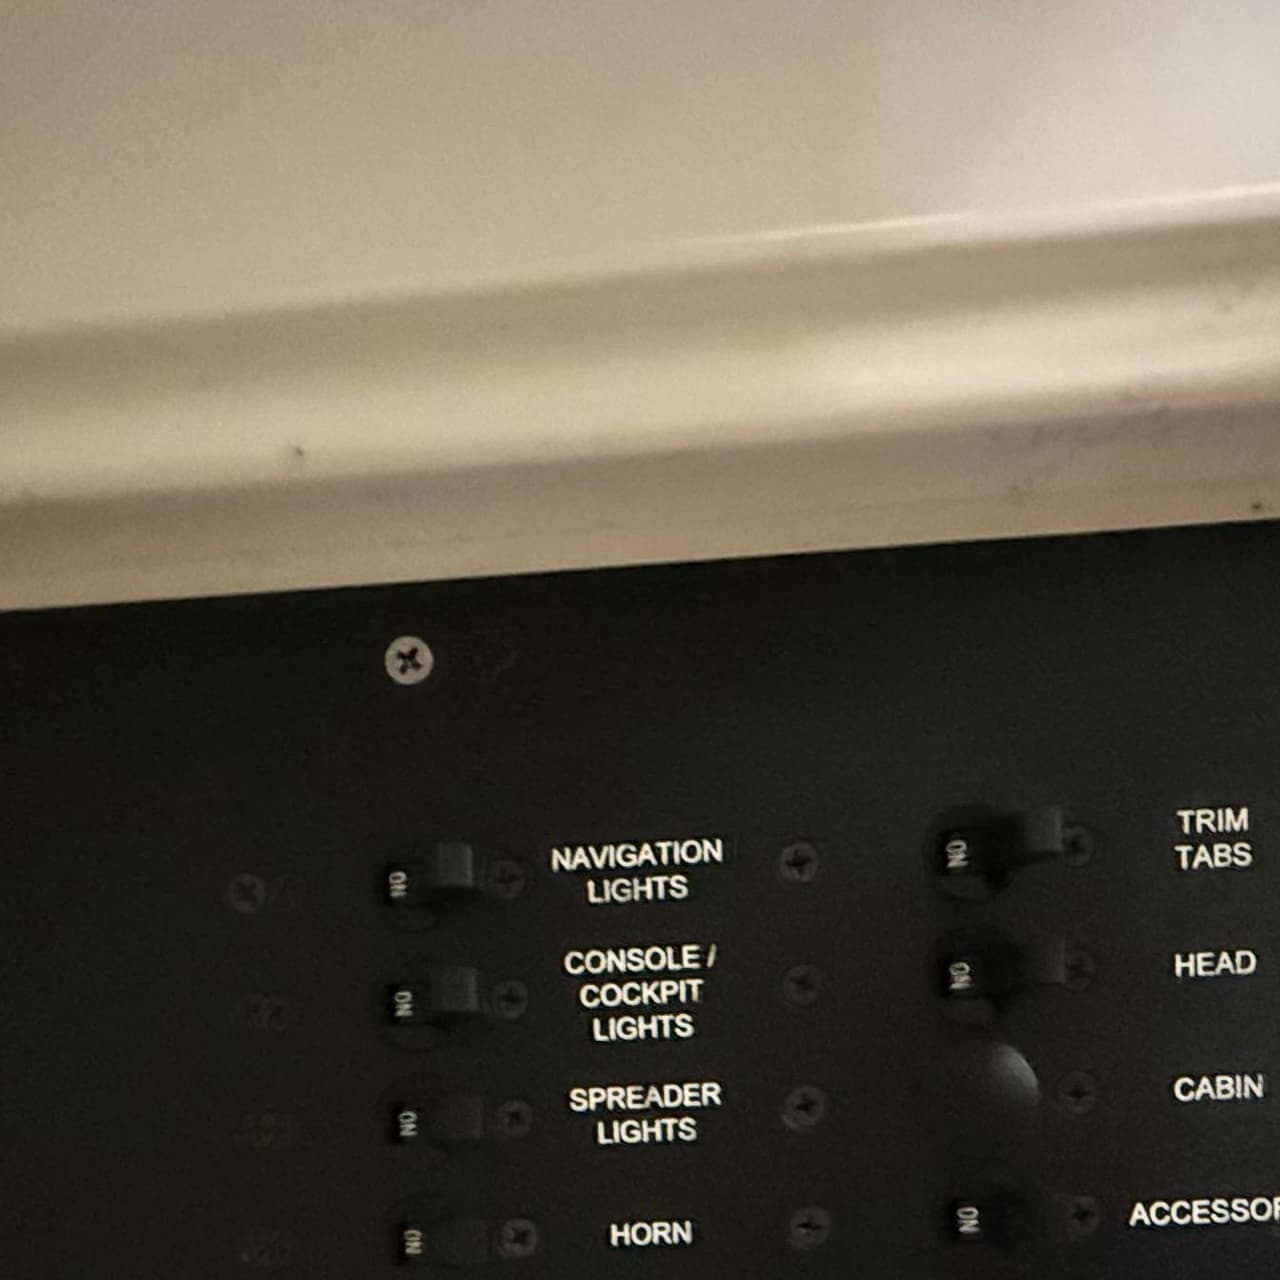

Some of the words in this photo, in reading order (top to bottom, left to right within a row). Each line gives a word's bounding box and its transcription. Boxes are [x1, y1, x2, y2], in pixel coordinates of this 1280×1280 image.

[1176, 806, 1250, 835] TRIM
[550, 838, 724, 872] NAVIGATION
[945, 839, 969, 868] ON
[1173, 841, 1254, 871] TABS
[389, 870, 408, 898] ON
[586, 873, 690, 904] LIGHTS
[948, 960, 973, 990] ON
[1174, 949, 1258, 978] HEAD
[393, 990, 414, 1017] ON
[578, 978, 705, 1009] COCKPIT
[592, 1012, 695, 1042] LIGHTS
[568, 1081, 723, 1112] SPREADER
[1173, 1073, 1265, 1102] CABIN
[398, 1110, 418, 1137] ON
[596, 1115, 698, 1146] LIGHTS
[609, 1219, 693, 1248] HORN
[955, 1205, 980, 1234] ON
[403, 1228, 423, 1256] ON
